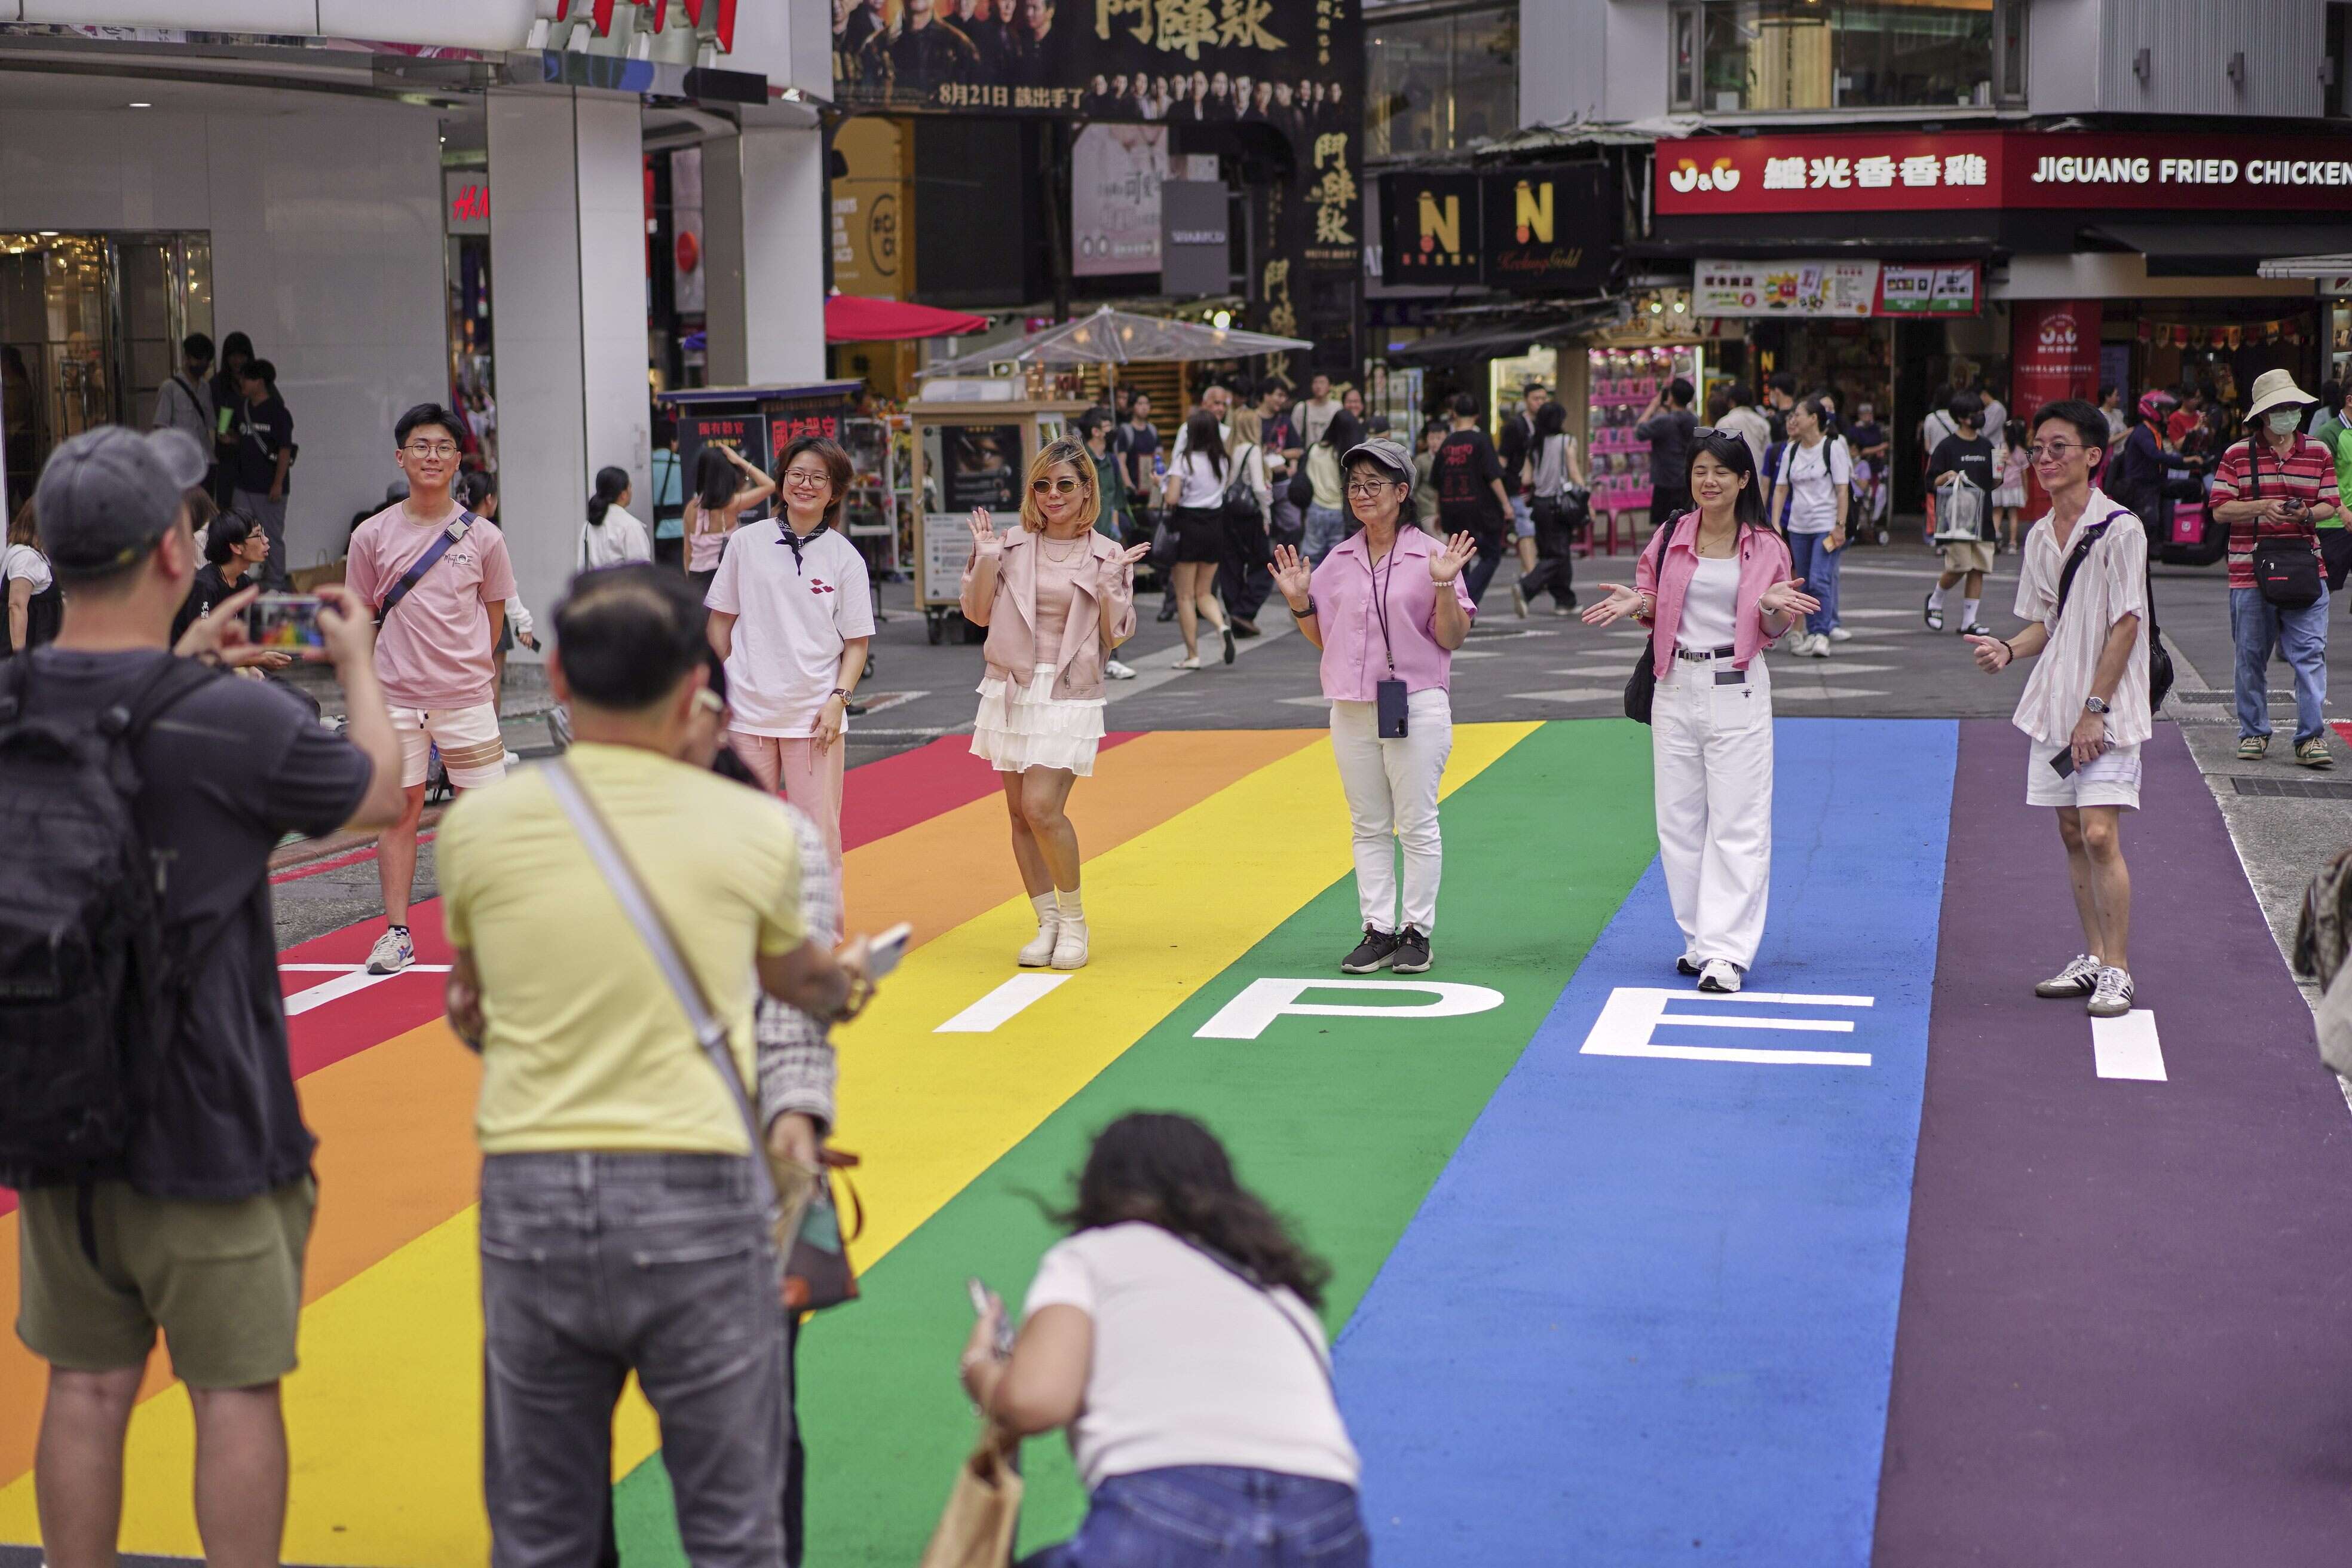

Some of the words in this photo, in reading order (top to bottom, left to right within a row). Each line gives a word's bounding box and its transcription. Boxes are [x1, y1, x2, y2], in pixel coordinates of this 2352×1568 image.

[939, 82, 1009, 108] 8月21日
[1670, 157, 1740, 193] J&G
[2032, 157, 2150, 184] JIGUANG
[2159, 158, 2238, 184] FRIED
